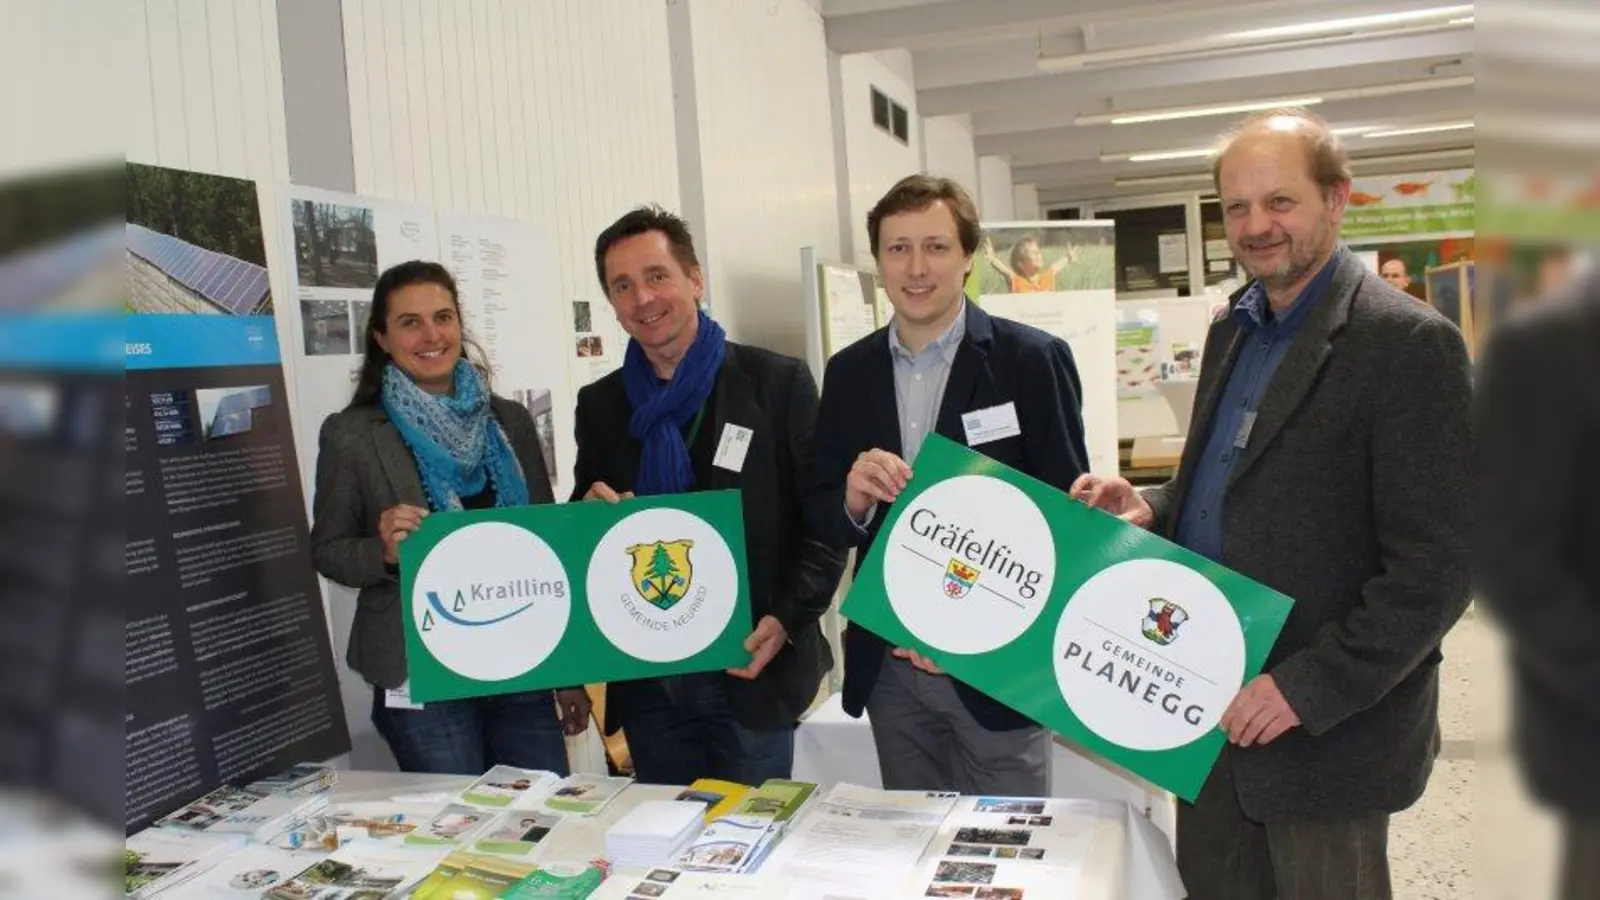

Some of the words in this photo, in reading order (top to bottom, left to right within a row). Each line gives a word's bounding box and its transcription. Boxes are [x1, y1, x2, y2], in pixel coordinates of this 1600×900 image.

[909, 507, 1043, 599] Gräfelfing
[470, 578, 565, 601] Krailling
[620, 592, 670, 632] GEMEINDE
[671, 583, 708, 630] NEURIED
[1063, 641, 1205, 727] PLANEGG
[1101, 639, 1186, 689] GEMEINDE
